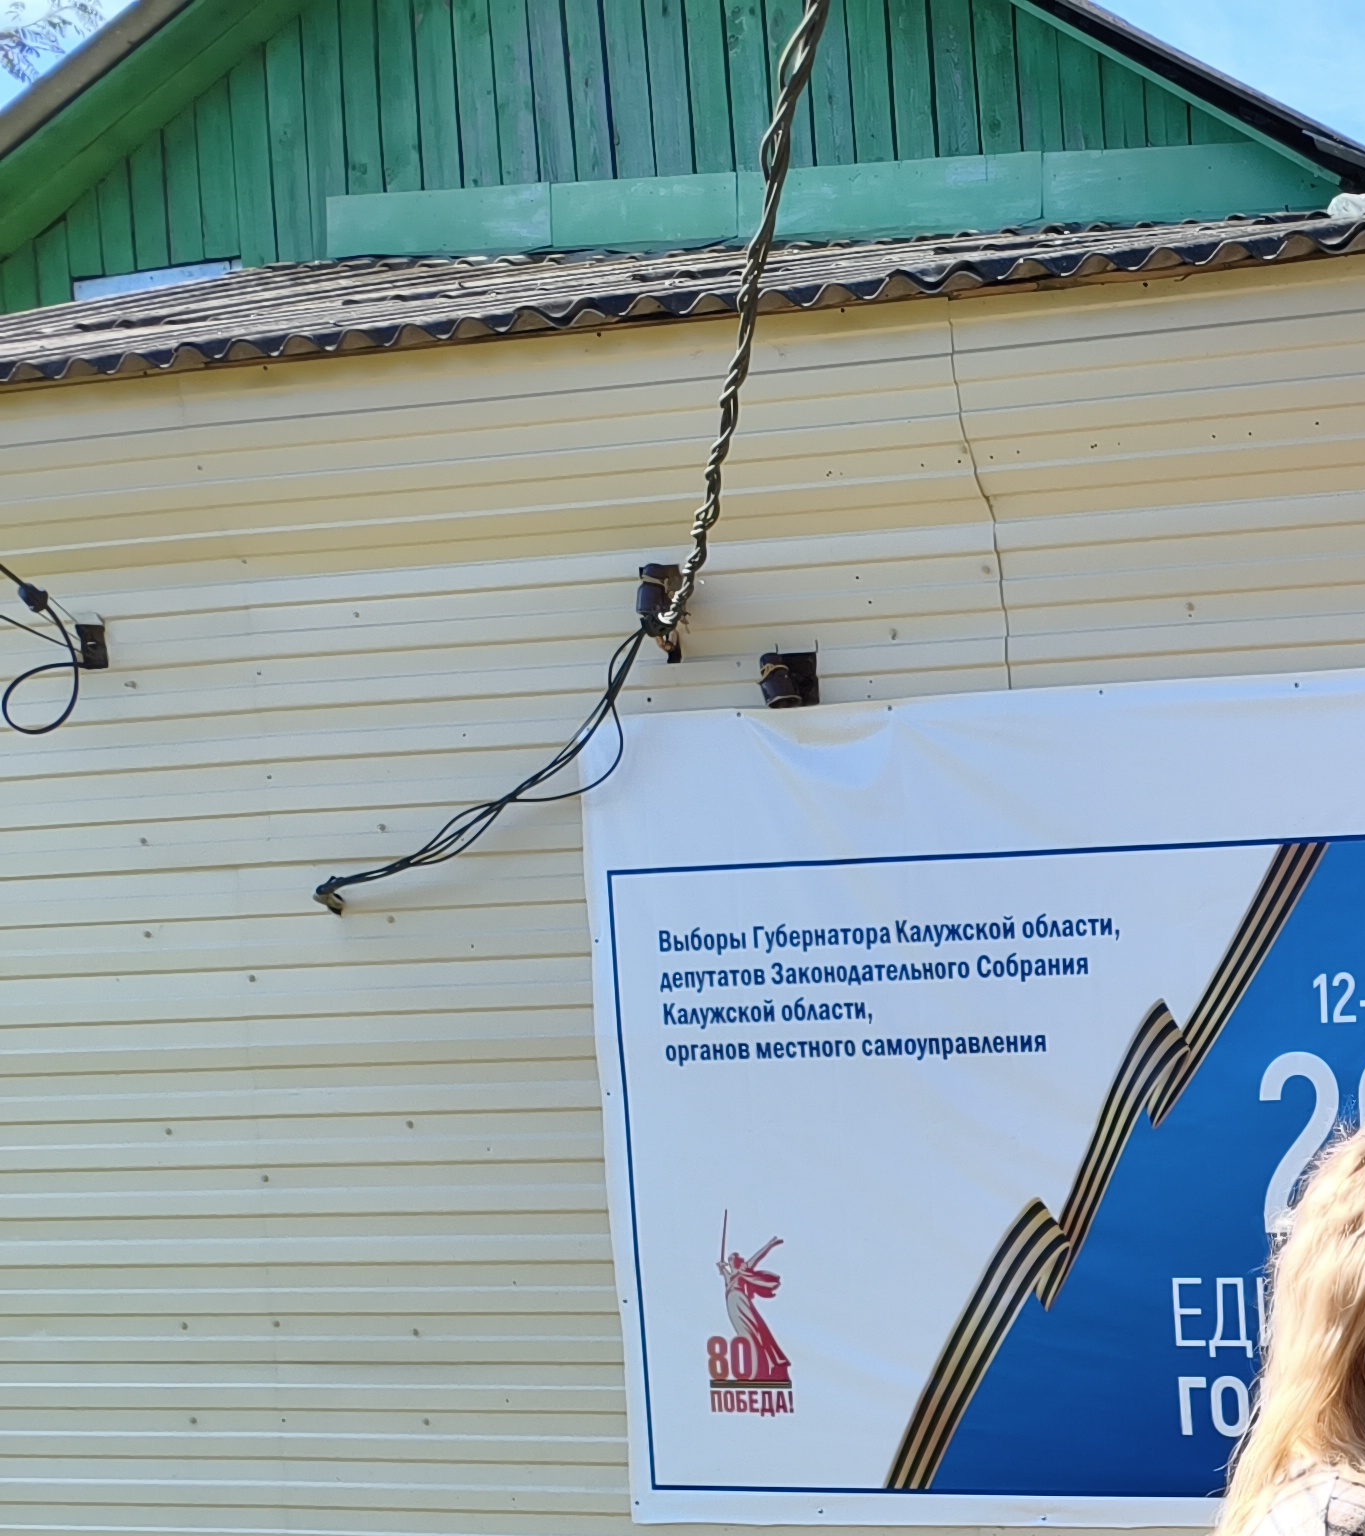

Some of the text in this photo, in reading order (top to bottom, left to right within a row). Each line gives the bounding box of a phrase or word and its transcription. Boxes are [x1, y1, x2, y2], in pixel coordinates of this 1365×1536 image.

[658, 913, 1121, 956] Выборы Губернатора Калужской области,
[659, 952, 1090, 994] депутатов Законодательного Собрания
[662, 997, 874, 1030] Калужской области,
[665, 1034, 1048, 1066] органов местного самоуправления
[706, 1335, 751, 1381] 80
[710, 1390, 794, 1416] ПОБЕДА!
